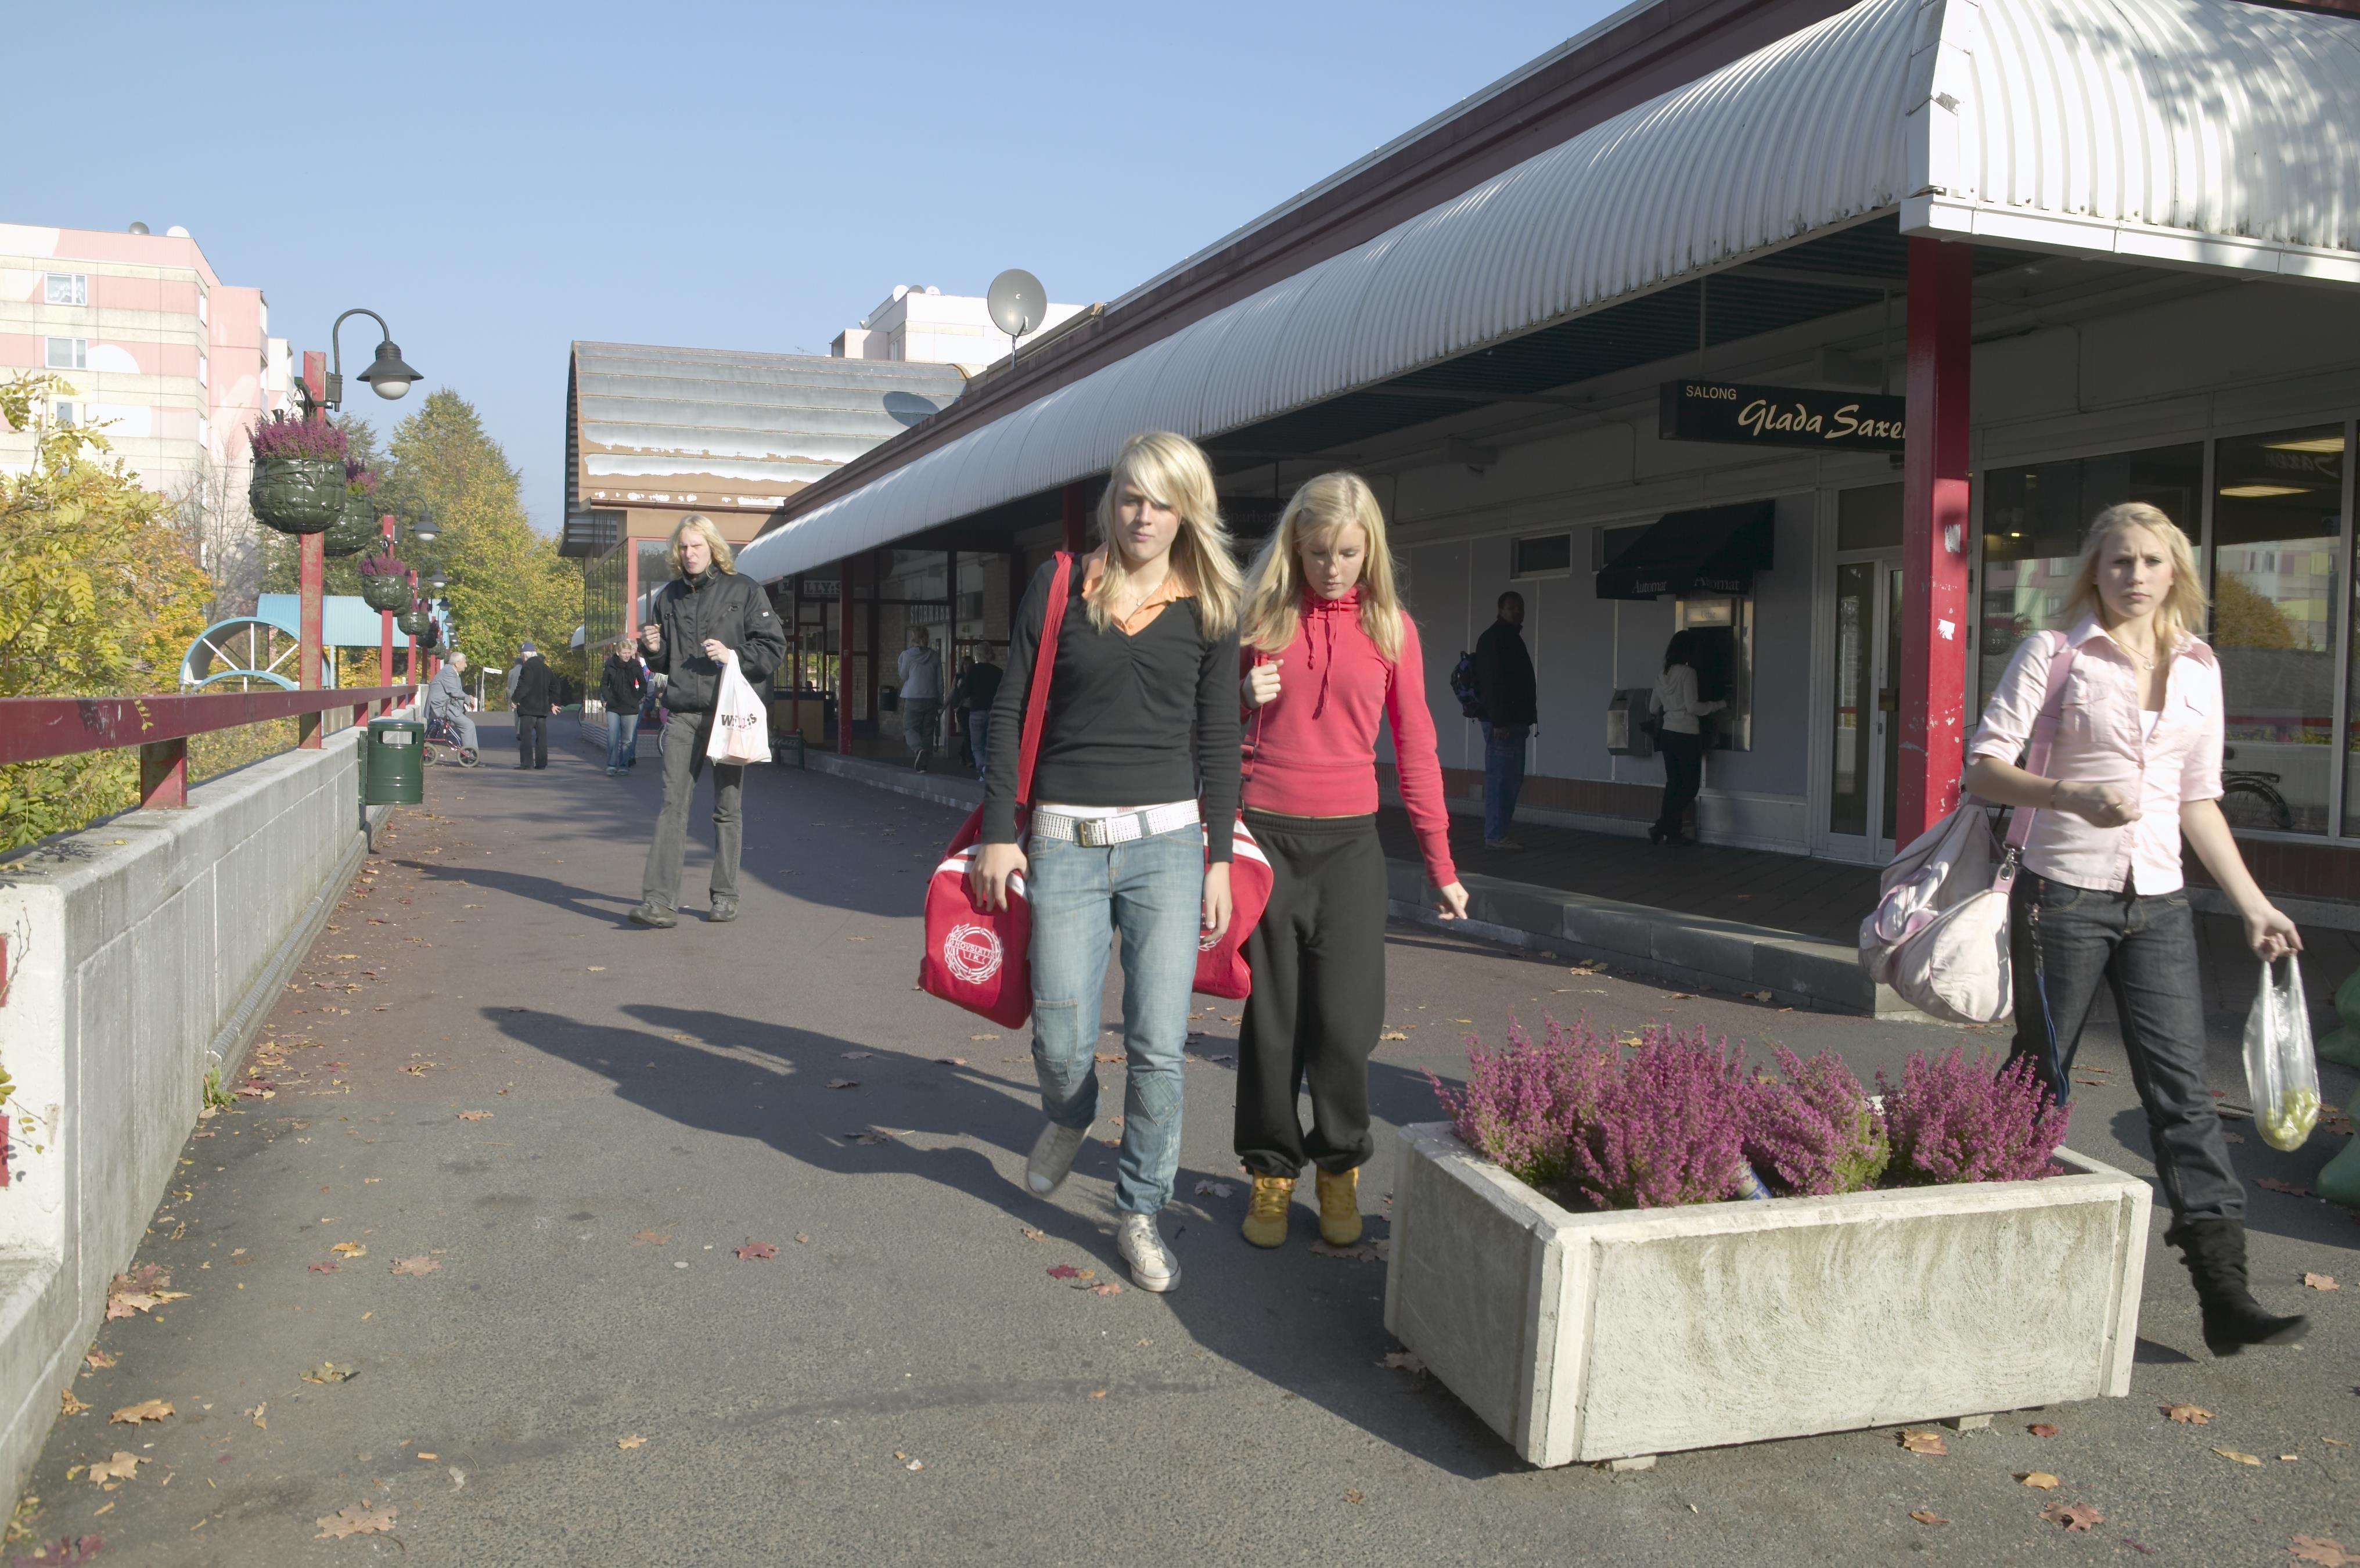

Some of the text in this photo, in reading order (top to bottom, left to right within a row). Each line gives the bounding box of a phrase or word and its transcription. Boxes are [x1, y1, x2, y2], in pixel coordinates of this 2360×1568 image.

[1686, 385, 1737, 400] SALONG
[1737, 399, 1906, 439] Glada Saxe
